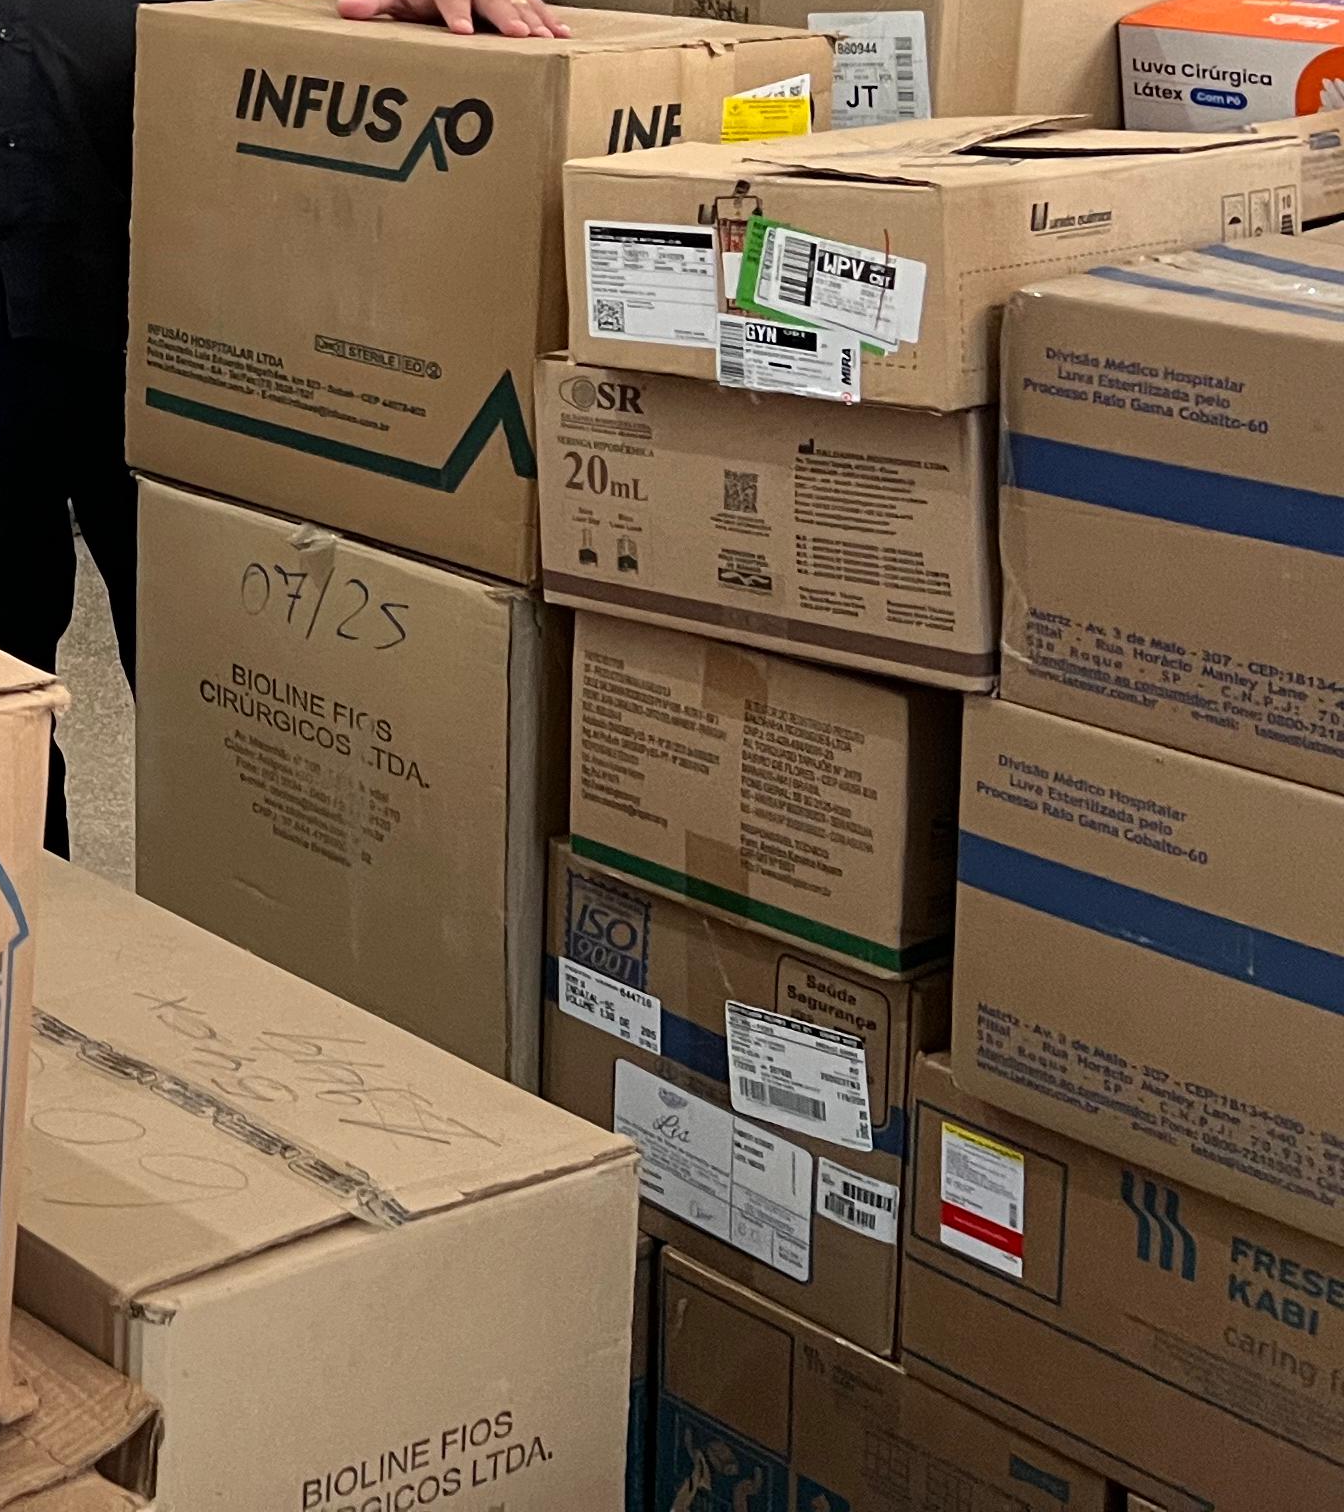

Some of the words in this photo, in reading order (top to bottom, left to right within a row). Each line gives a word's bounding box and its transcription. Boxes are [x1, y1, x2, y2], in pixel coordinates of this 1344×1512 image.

[846, 85, 879, 109] JT
[1132, 58, 1176, 75] Luva
[1181, 63, 1273, 88] Cirúrgica
[1134, 82, 1183, 101] Látex
[1196, 91, 1225, 105] Com
[823, 252, 865, 280] WPV
[147, 323, 189, 344] INFUSÃO
[190, 334, 254, 361] HOSPITALAR
[256, 352, 284, 369] LTDA
[746, 323, 777, 344] GYN
[348, 345, 395, 367] STERILE
[405, 359, 422, 373] EO
[841, 348, 852, 386] MIRA
[1046, 347, 1099, 368] Divisão
[1104, 357, 1159, 378] Médico
[1163, 366, 1245, 394] Hospitalar
[596, 381, 645, 415] SR
[1023, 378, 1088, 402] Processo
[1092, 390, 1126, 409] Raio
[1131, 398, 1174, 418] Gama
[1179, 406, 1268, 435] Cobalto-60
[1098, 375, 1190, 403] Esterilizada
[1195, 393, 1231, 409] pelo
[241, 562, 409, 650] 07/25
[1029, 607, 1071, 628] Matriz
[1085, 621, 1107, 637] Av.
[1126, 632, 1145, 646] de
[1150, 637, 1186, 656] Maio
[1202, 648, 1232, 667] 307
[1026, 621, 1062, 641] Filial
[1095, 638, 1125, 656] Rua
[1133, 647, 1193, 673] Horácio
[1201, 664, 1258, 690] Manley
[1268, 680, 1309, 702] Lane
[230, 662, 326, 719] BIOLINE
[1222, 701, 1263, 721] Fone:
[199, 679, 352, 757] CIRÚRGICOS
[366, 745, 431, 789] TDA.
[998, 754, 1050, 780] Divisão
[1053, 770, 1106, 798] Médico
[1109, 788, 1187, 823] Hospitalar
[1009, 774, 1044, 796] Luva
[1048, 787, 1134, 825] Esterilizada
[1139, 818, 1173, 837] pelo
[976, 780, 1038, 811] Processo
[1042, 801, 1075, 823] Raio
[1078, 814, 1120, 838] Gama
[1124, 828, 1208, 866] Cobalto-60
[577, 903, 638, 951] ISO
[576, 938, 635, 982] 9001
[565, 992, 596, 1014] VOLUME
[787, 984, 878, 1032] Segurança
[806, 974, 857, 1007] Saúde
[978, 1001, 1021, 1027] Matriz
[1071, 1039, 1091, 1055] de
[1092, 1047, 1128, 1069] Maio
[1142, 1064, 1170, 1083] 307
[977, 1014, 1011, 1037] Filial
[1042, 1040, 1069, 1060] Rua
[1077, 1053, 1134, 1085] Horácio
[1141, 1080, 1196, 1110] Manley
[1203, 1104, 1242, 1125] Lane
[1161, 1116, 1199, 1141] Fone:
[1228, 1272, 1320, 1336] KABI
[1223, 1326, 1317, 1387] caring
[302, 1437, 431, 1512] BIOLINE
[441, 1410, 513, 1461] FIOS
[472, 1436, 554, 1488] LTDA.
